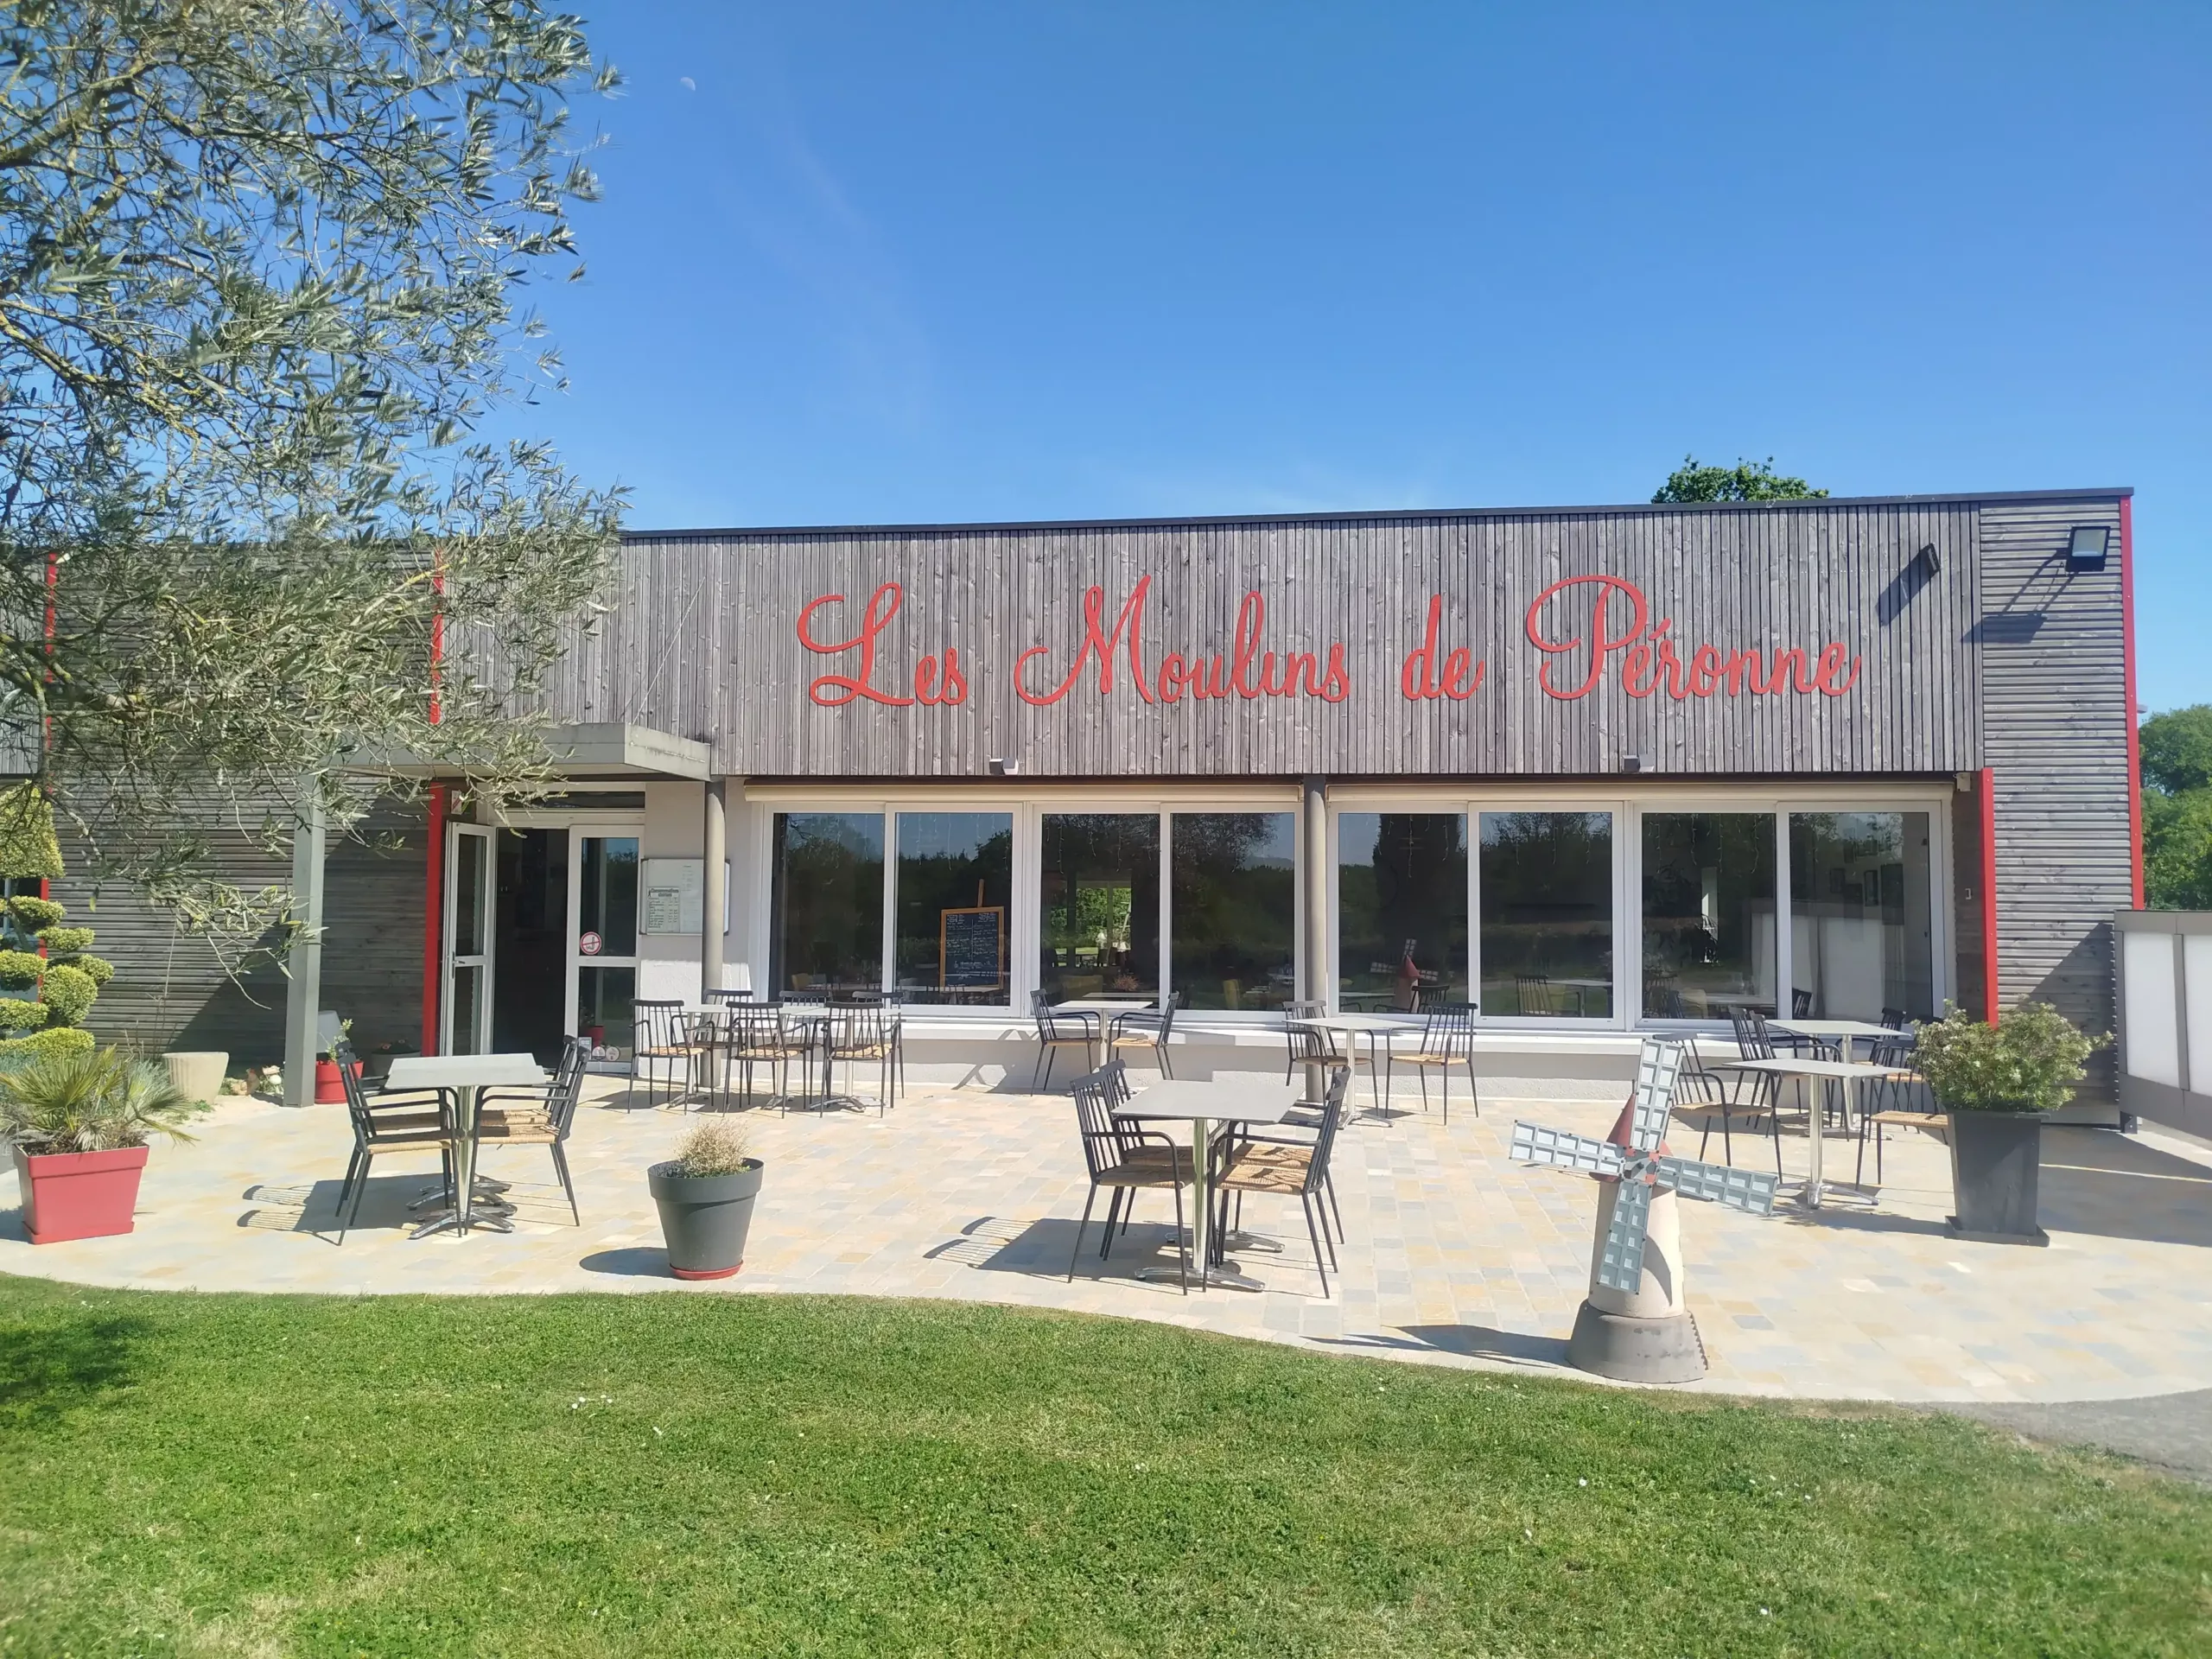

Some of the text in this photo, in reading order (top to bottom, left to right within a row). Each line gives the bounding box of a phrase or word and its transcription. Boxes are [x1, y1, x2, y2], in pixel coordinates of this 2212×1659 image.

[796, 575, 1861, 707] Les Moulins de Péronne
